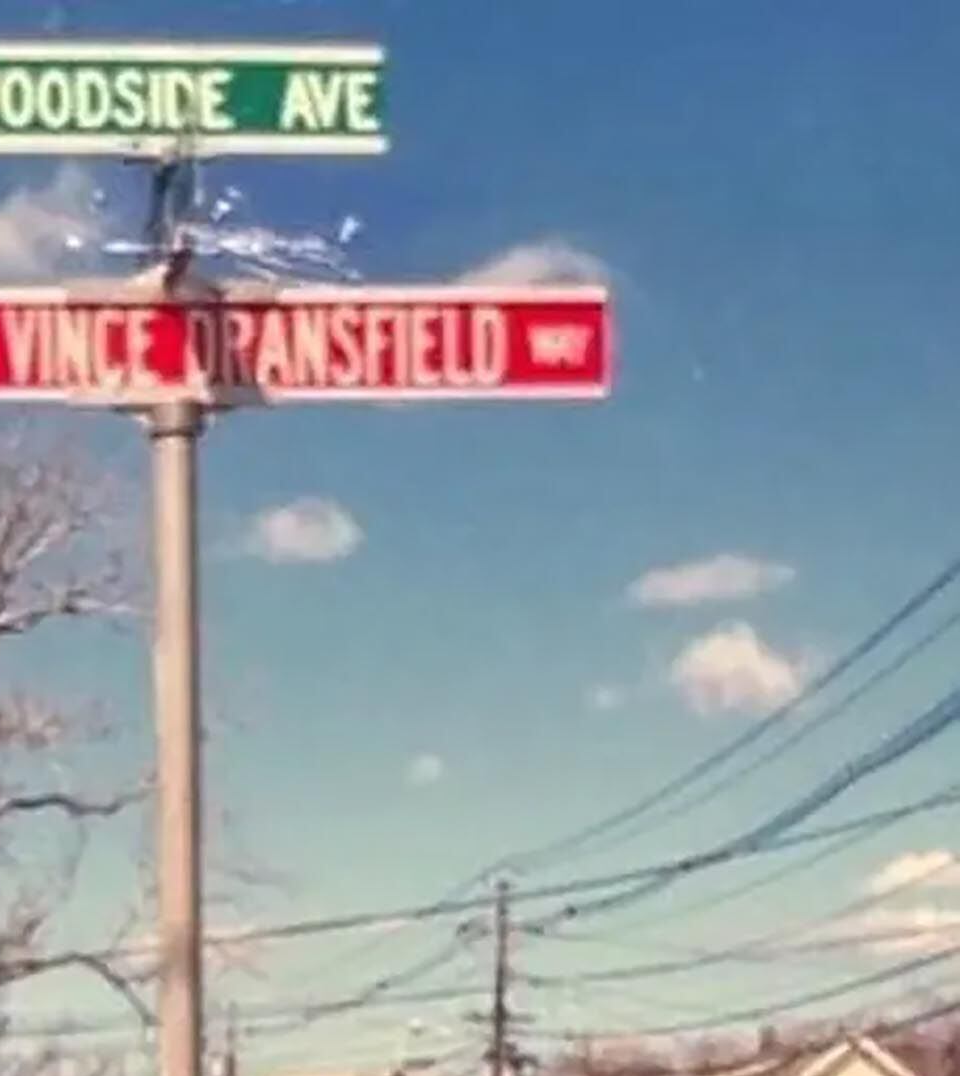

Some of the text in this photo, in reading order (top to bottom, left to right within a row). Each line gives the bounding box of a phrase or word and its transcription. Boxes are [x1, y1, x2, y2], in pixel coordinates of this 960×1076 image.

[279, 70, 381, 131] AVE
[3, 305, 160, 387] VINCE
[186, 305, 509, 387] DRANSFIELD
